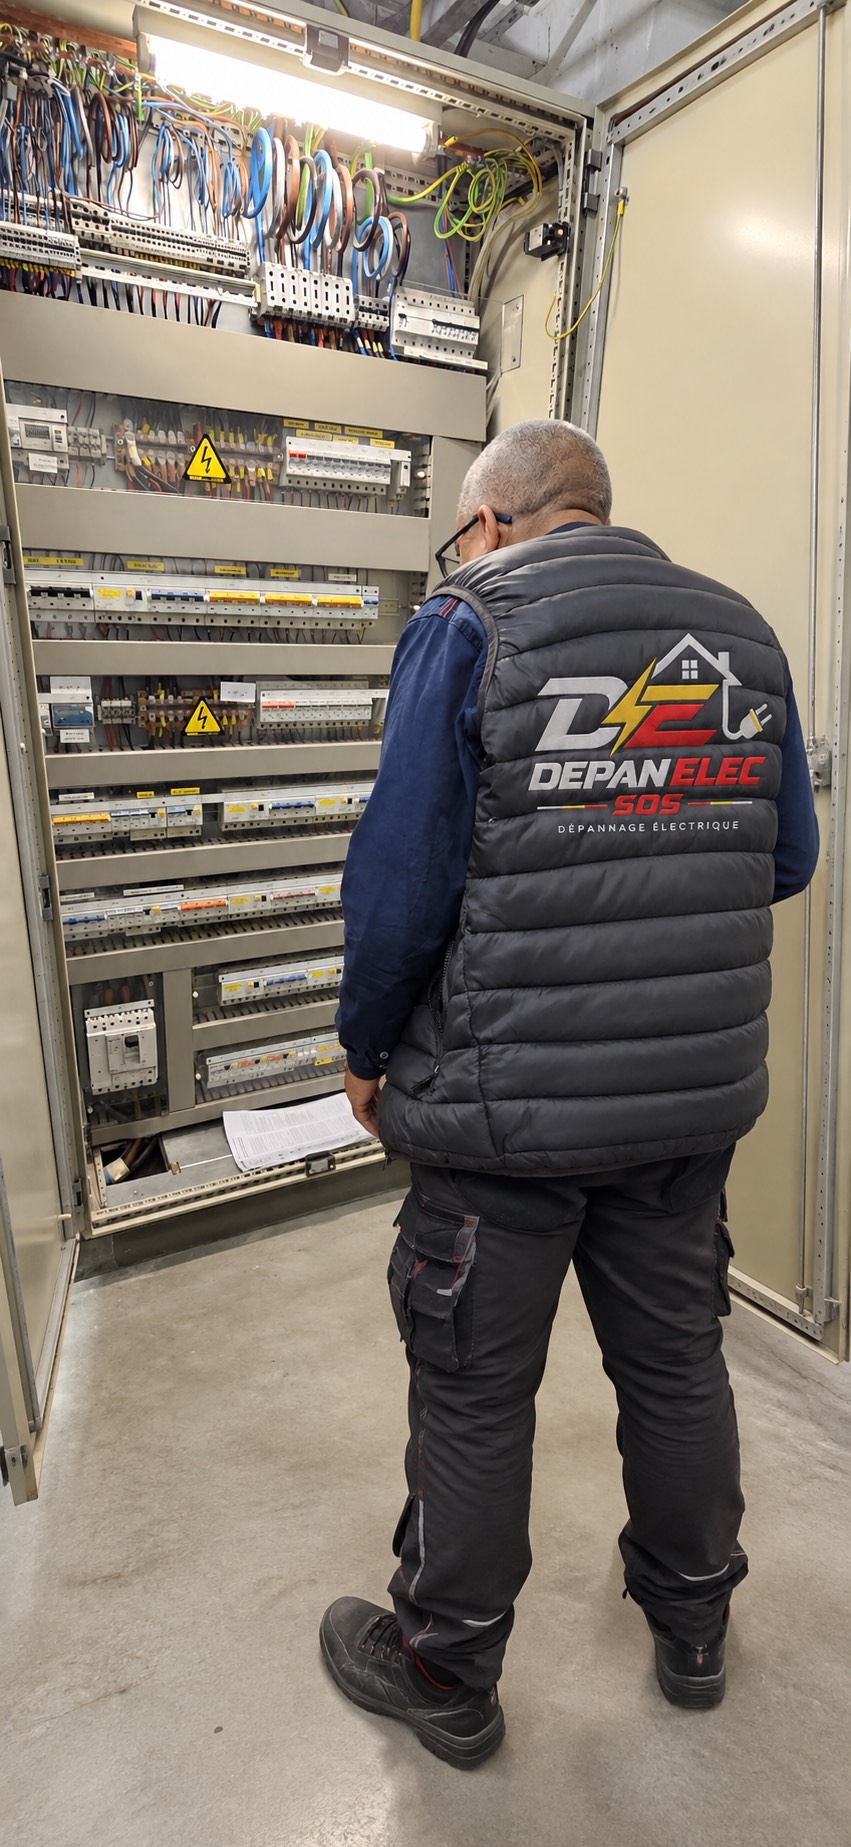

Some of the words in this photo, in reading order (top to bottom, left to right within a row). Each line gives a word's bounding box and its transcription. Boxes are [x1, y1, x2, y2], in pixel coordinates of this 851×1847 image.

[611, 793, 686, 816] SOS
[558, 823, 646, 834] DÉPANNAGE
[652, 820, 740, 832] ÉLECTRIQUE
